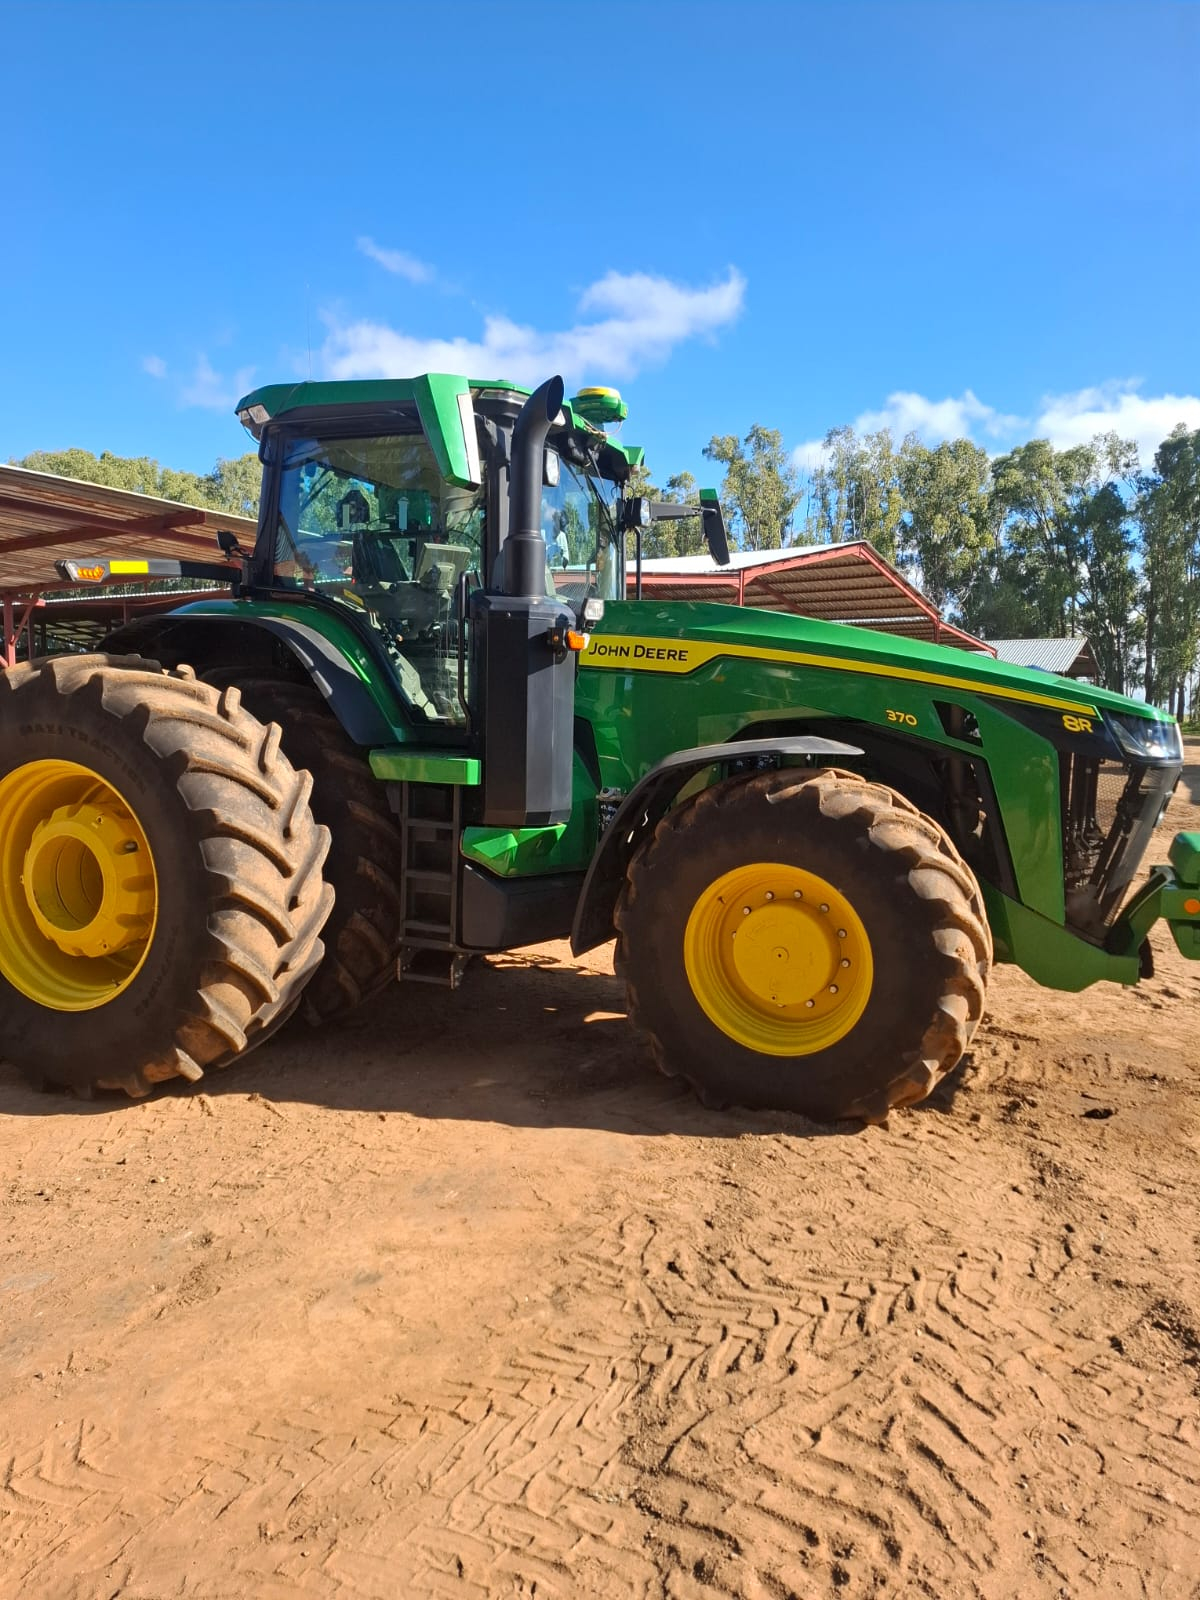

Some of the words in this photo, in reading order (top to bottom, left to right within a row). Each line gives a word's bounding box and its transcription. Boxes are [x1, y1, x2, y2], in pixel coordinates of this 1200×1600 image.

[588, 642, 630, 657] JOHN
[633, 644, 688, 661] DEERE
[886, 710, 917, 726] 370
[1062, 715, 1094, 733] 8R
